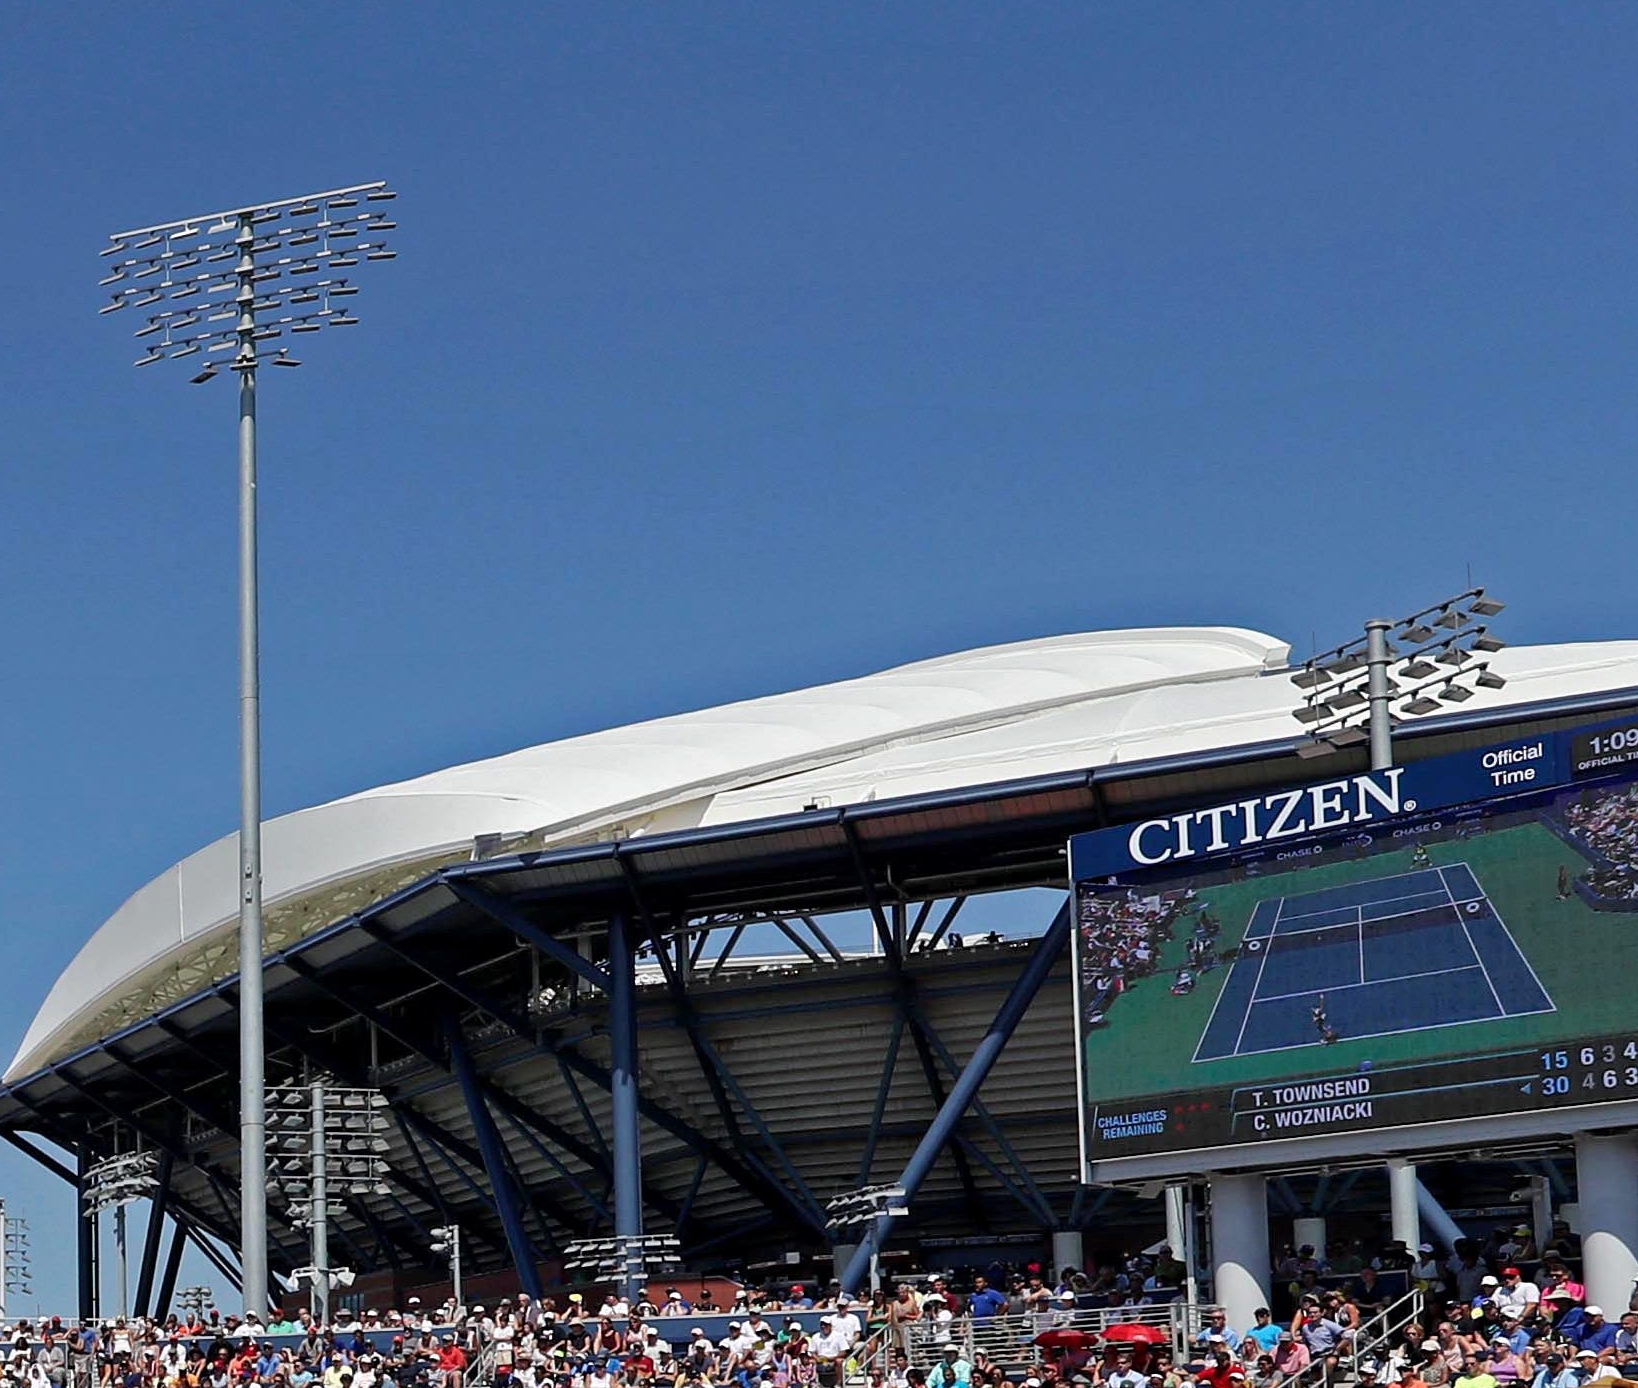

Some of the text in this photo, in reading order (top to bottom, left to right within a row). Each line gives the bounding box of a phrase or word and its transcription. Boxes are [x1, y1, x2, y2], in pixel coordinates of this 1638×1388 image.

[1589, 728, 1638, 754] 1:09
[1482, 742, 1543, 768] Official
[1578, 755, 1625, 770] OFFICIAL
[1490, 767, 1536, 787] Time
[1541, 1050, 1568, 1070] 15
[1580, 1041, 1638, 1065] 6 3 4
[1542, 1076, 1570, 1095] 30
[1582, 1067, 1638, 1089] 4 6 3
[1252, 1077, 1371, 1108] T. TOWNSEND
[1097, 1109, 1167, 1129] CHALLENGES
[1254, 1101, 1373, 1131] C. WOZNIACKI
[1102, 1122, 1164, 1141] REMAINING
